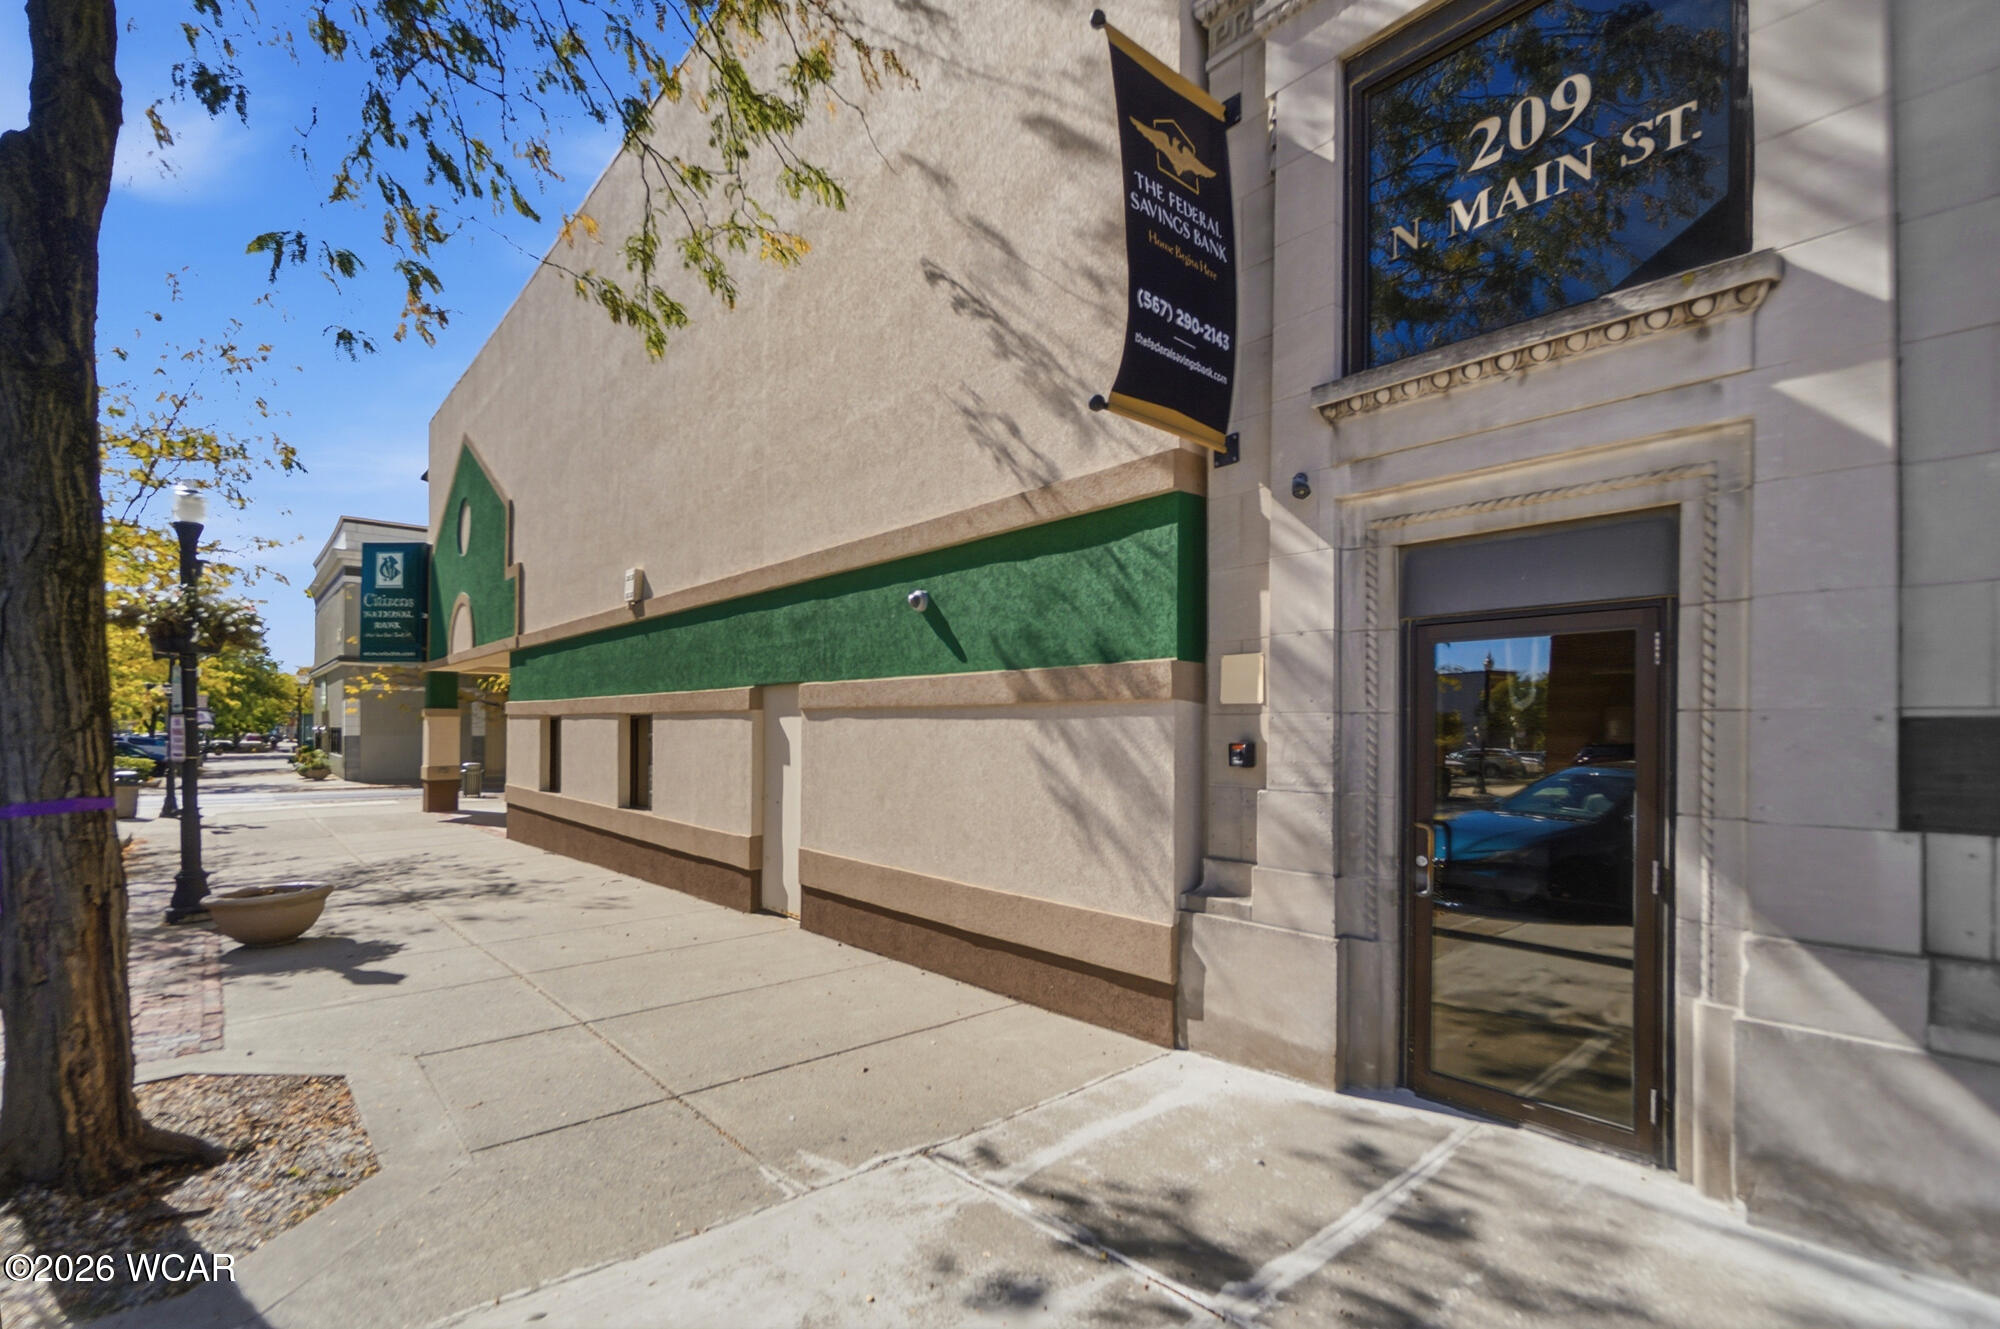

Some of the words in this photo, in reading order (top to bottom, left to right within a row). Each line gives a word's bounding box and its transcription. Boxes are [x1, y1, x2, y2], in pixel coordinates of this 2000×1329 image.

[1467, 72, 1592, 173] 209
[1447, 142, 1595, 238] MAIN
[1619, 100, 1703, 168] ST.
[1131, 191, 1191, 240] SAVINGS
[1194, 228, 1228, 263] BANK
[1134, 170, 1165, 202] THE
[1169, 191, 1222, 238] FEDERAL
[1148, 229, 1174, 255] Home
[1137, 287, 1173, 323] (567)
[1175, 307, 1230, 351] 290-2143
[1134, 331, 1228, 385] thefederalsavingsbank.com
